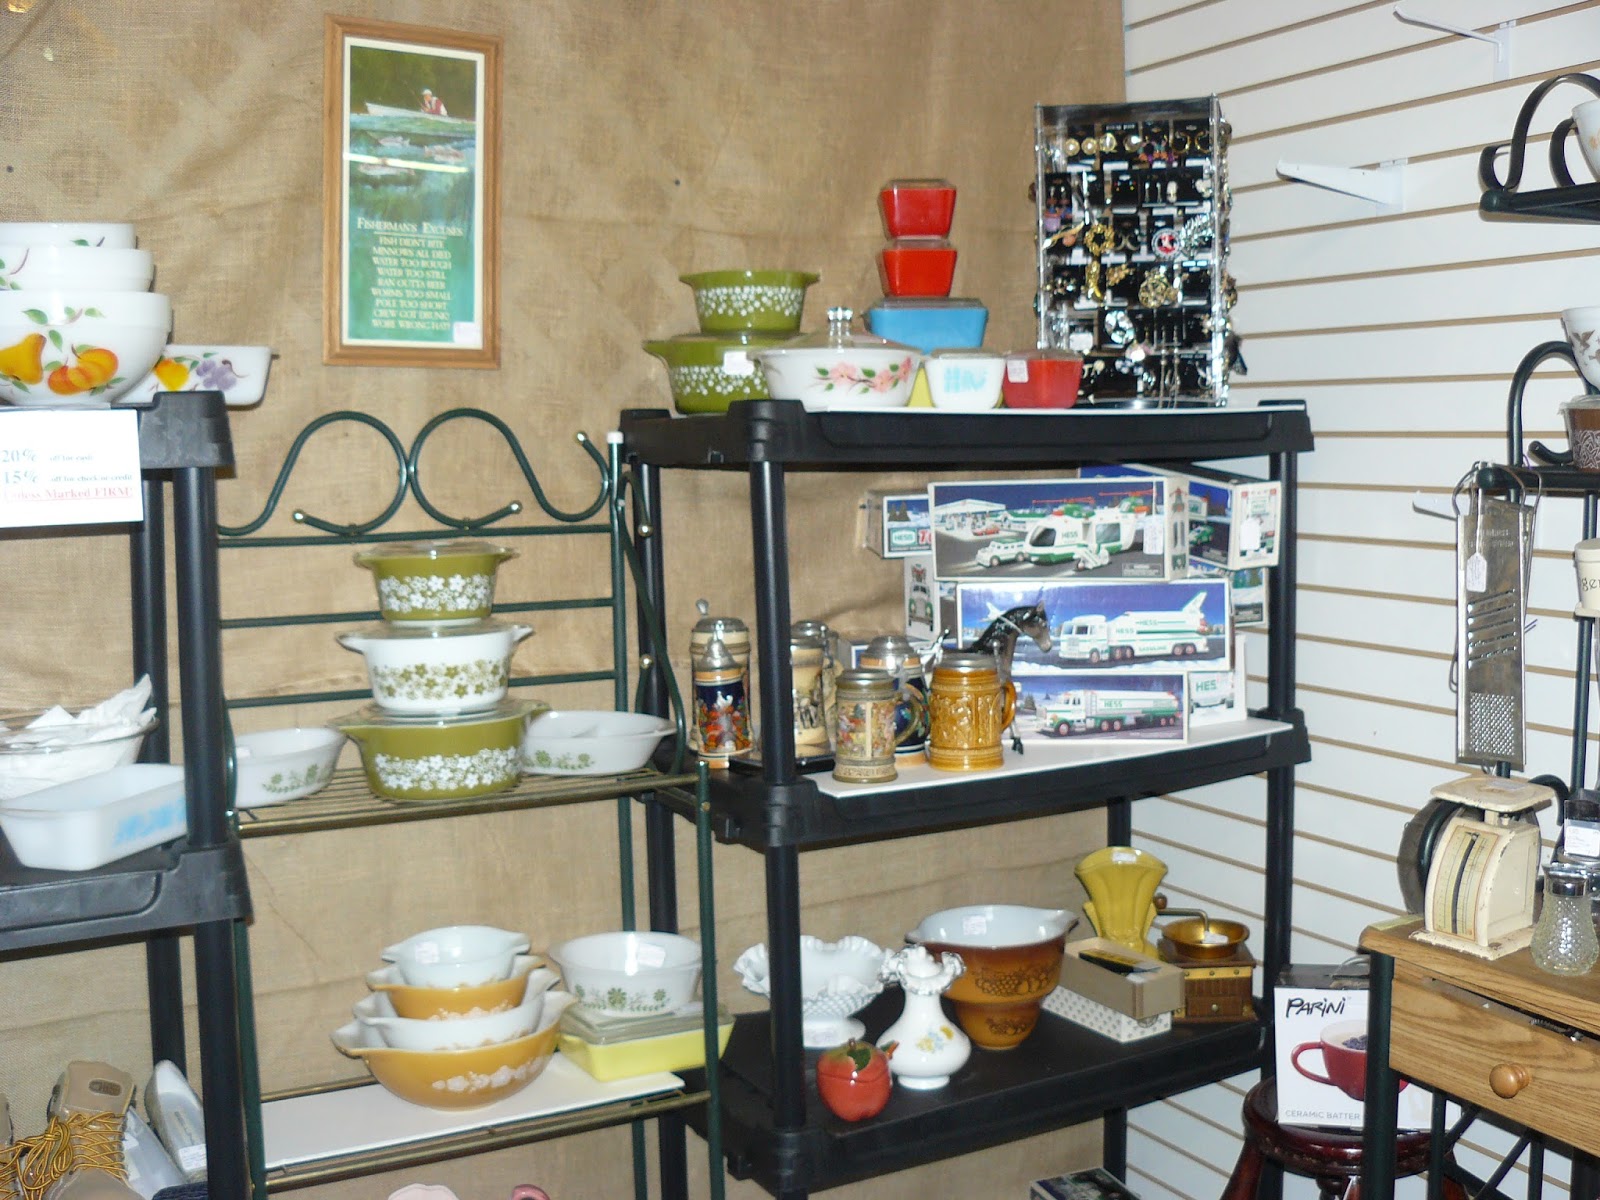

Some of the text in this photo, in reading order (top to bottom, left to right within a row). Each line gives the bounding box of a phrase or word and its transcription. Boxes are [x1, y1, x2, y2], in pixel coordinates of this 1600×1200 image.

[422, 221, 464, 237] EXCUSES
[379, 236, 397, 246] FISH
[372, 246, 452, 259] MINNOWS ALL DIED
[372, 257, 452, 270] WATER TOO ROUGH
[377, 267, 447, 280] WATER TOO STILL
[405, 289, 424, 298] TOO
[425, 291, 452, 301] SMALL
[399, 300, 418, 308] TOO
[2, 448, 38, 462] 20%
[4, 469, 39, 484] 15%
[110, 473, 133, 481] credit
[45, 488, 91, 499] Marked
[1582, 577, 1600, 591] ge
[1285, 1109, 1361, 1121] CERAMIC BATTER
